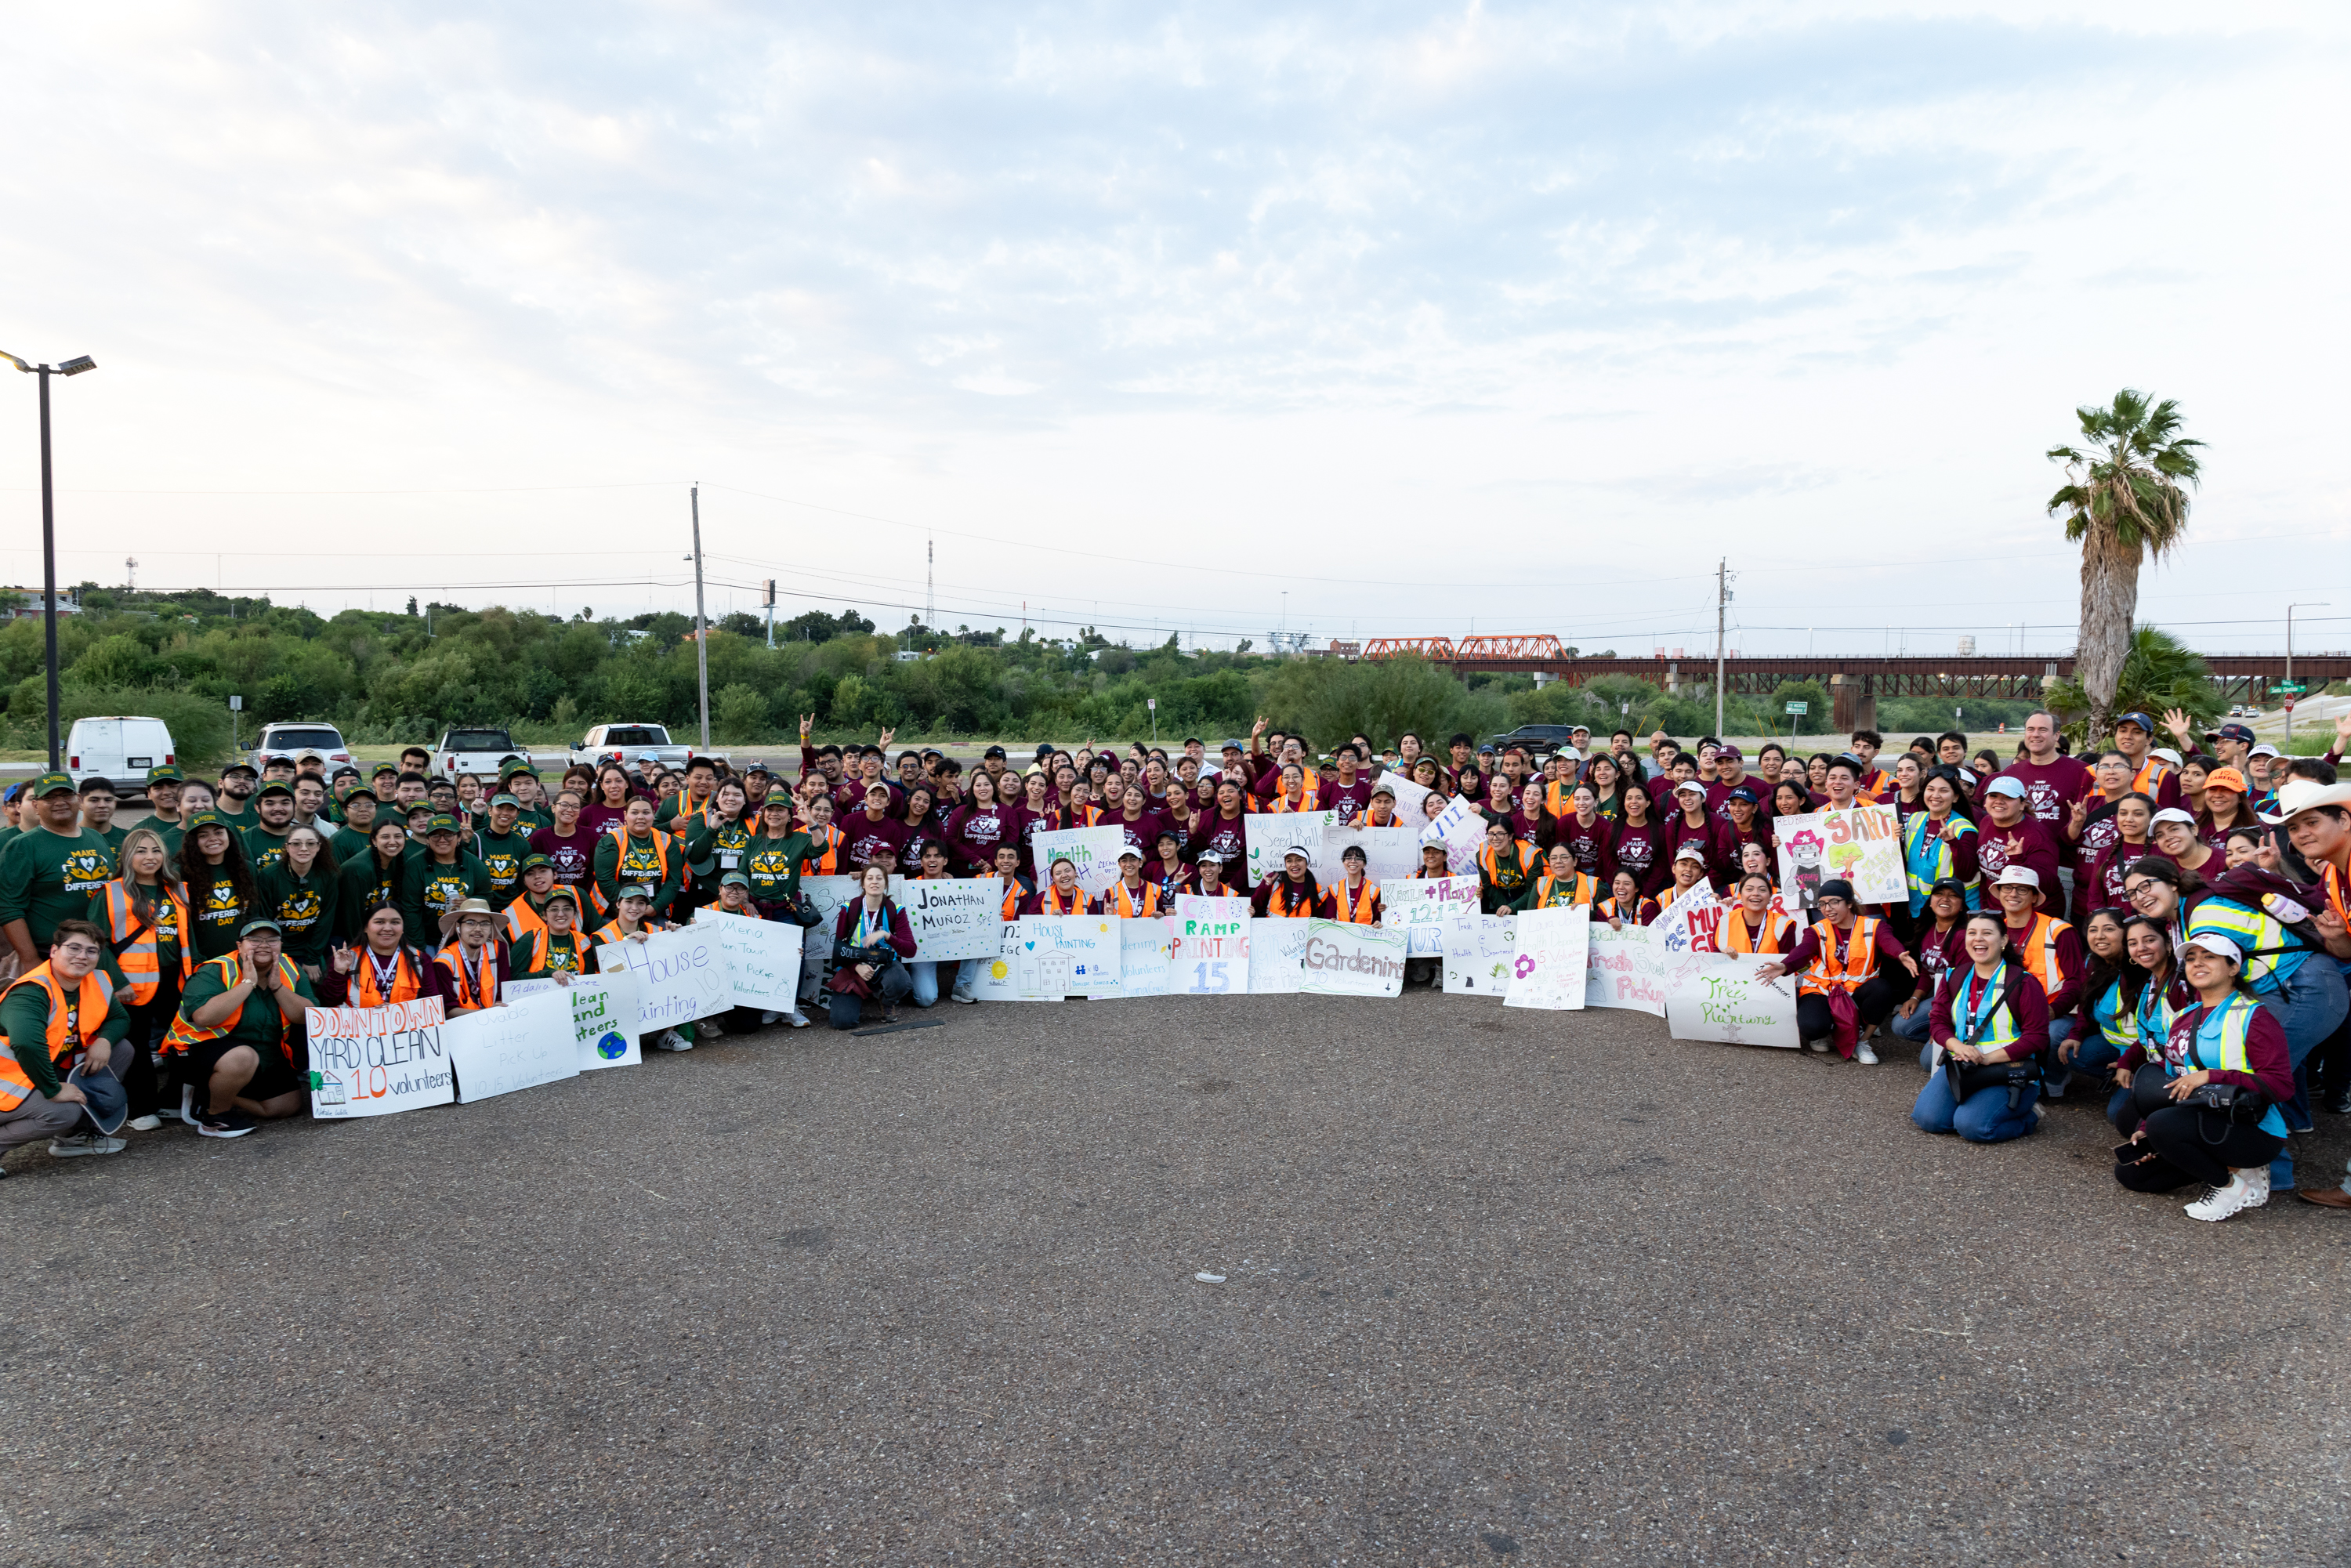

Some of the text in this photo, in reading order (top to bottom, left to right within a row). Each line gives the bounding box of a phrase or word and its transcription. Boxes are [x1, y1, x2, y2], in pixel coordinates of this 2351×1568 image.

[2210, 775, 2238, 784] LAREDO
[518, 820, 537, 829] MAKE
[1776, 813, 1821, 827] RED BRACELET
[2092, 822, 2115, 831] MAKE
[1038, 831, 1080, 847] AMERICA
[1262, 828, 1292, 847] Seed
[71, 849, 98, 858] MAKE
[1986, 840, 2005, 852] MAKE
[1886, 878, 1900, 890] 10
[1183, 898, 1242, 919] CARO
[217, 917, 235, 925] DAY
[922, 914, 970, 930] MUÑOZ
[1186, 920, 1241, 936] RAMP
[721, 921, 765, 940] Mena
[1033, 923, 1064, 936] HOUSE
[1292, 930, 1305, 942] 10
[1055, 936, 1095, 949] PAINTING
[1172, 936, 1250, 960] PAINTING
[1517, 934, 1546, 954] Health
[841, 947, 860, 958] SOLE
[1306, 937, 1405, 980] Gardening
[1452, 948, 1473, 958] Health
[1538, 950, 1545, 964] 15
[1587, 948, 1633, 972] Trash
[1632, 947, 1650, 973] 5
[1925, 948, 1941, 958] MAKE
[624, 943, 710, 984] House
[1189, 962, 1230, 994] 15
[1309, 971, 1328, 984] 10
[1701, 976, 1746, 999] Tree
[572, 990, 609, 1007] lean
[307, 996, 444, 1037] DOWNTOWN
[638, 996, 696, 1021] ainting
[482, 1030, 529, 1048] Litter
[310, 1027, 440, 1069] YARD CLEAN
[351, 1066, 452, 1100] 10 volunteers
